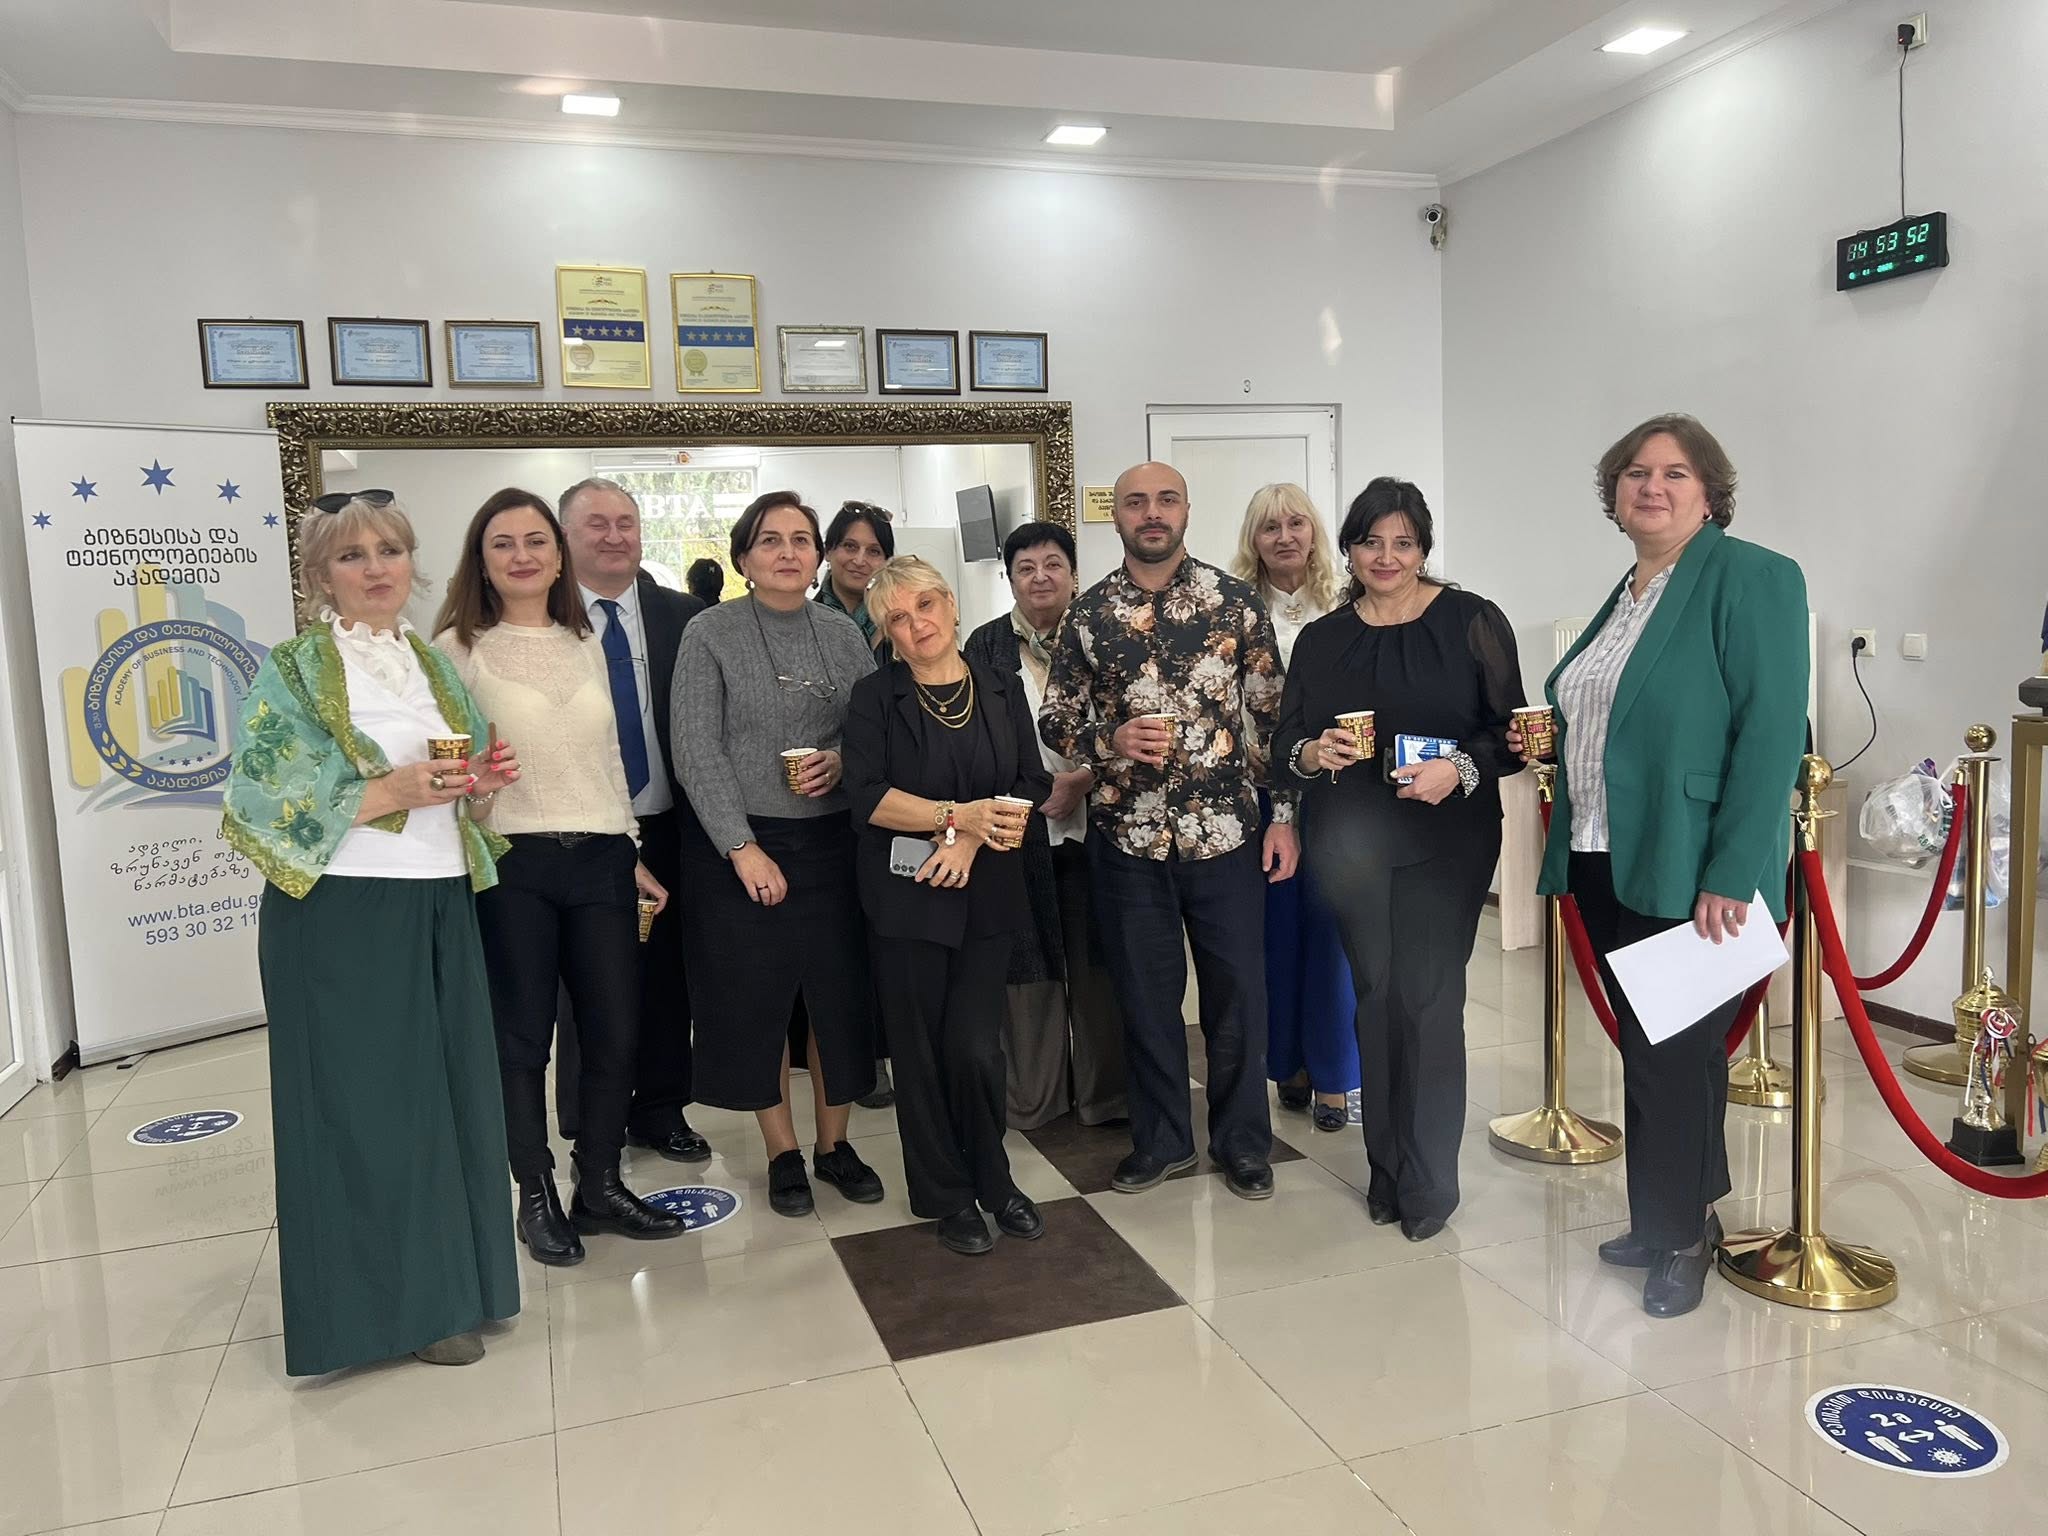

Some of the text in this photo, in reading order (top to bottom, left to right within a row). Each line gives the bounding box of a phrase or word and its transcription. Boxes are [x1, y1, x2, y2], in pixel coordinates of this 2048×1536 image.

[1850, 223, 1929, 261] 14 53 52
[642, 494, 712, 518] BTA
[84, 529, 238, 545] ბიზნესისა და
[67, 548, 257, 566] ტექნოლოგიების
[114, 568, 219, 586] აკადემია
[134, 628, 158, 641] და
[115, 646, 242, 706] ACADEMY OF BUSINESS AND TECHNOLOGY
[110, 850, 202, 876] ზრუნავენ
[134, 863, 249, 891] წარმატებაზე
[146, 927, 179, 945] 593
[185, 921, 206, 938] 30
[213, 916, 234, 933] 32
[1857, 1390, 1961, 1419] დისტანცია
